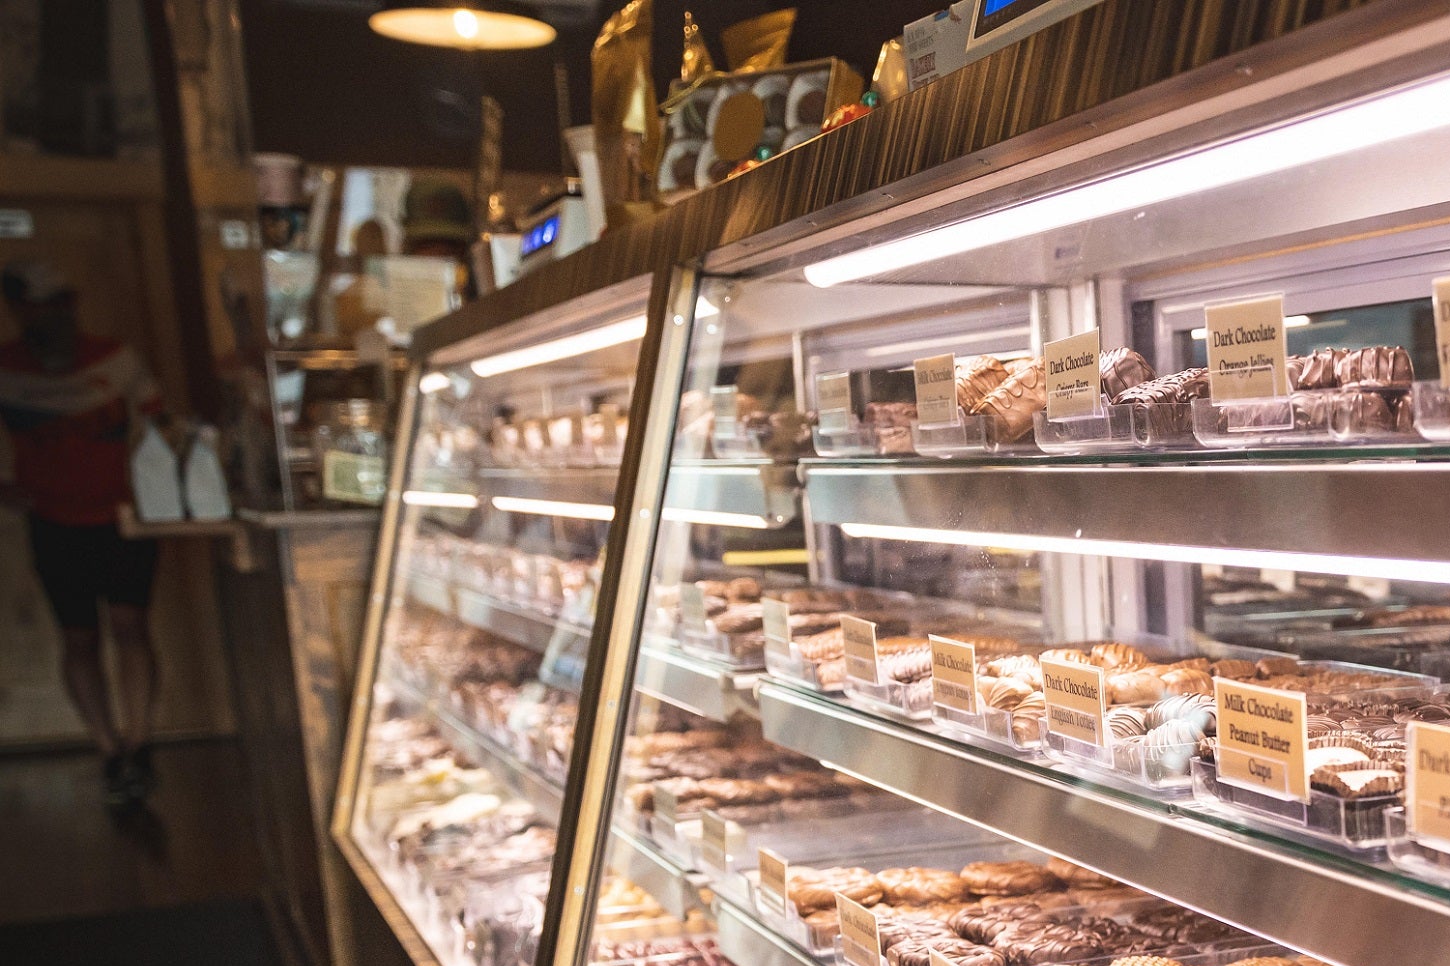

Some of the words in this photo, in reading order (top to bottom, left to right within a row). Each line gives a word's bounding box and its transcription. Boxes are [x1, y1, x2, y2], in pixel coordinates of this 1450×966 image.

[1213, 328, 1235, 348] Dark
[1235, 323, 1276, 345] Chocolate
[1050, 358, 1065, 375] Dark
[1065, 351, 1094, 371] Chocolate
[1219, 359, 1248, 379] Orange
[947, 653, 973, 674] Chocolate
[1045, 673, 1063, 691] Dark
[1063, 677, 1098, 700] Chocolate
[1224, 693, 1245, 713] Milk
[1247, 698, 1294, 724] Chocolate
[1229, 723, 1260, 746] Peanut
[1261, 731, 1291, 754] Butter
[1248, 758, 1272, 783] Cups
[1418, 748, 1450, 774] Dark
